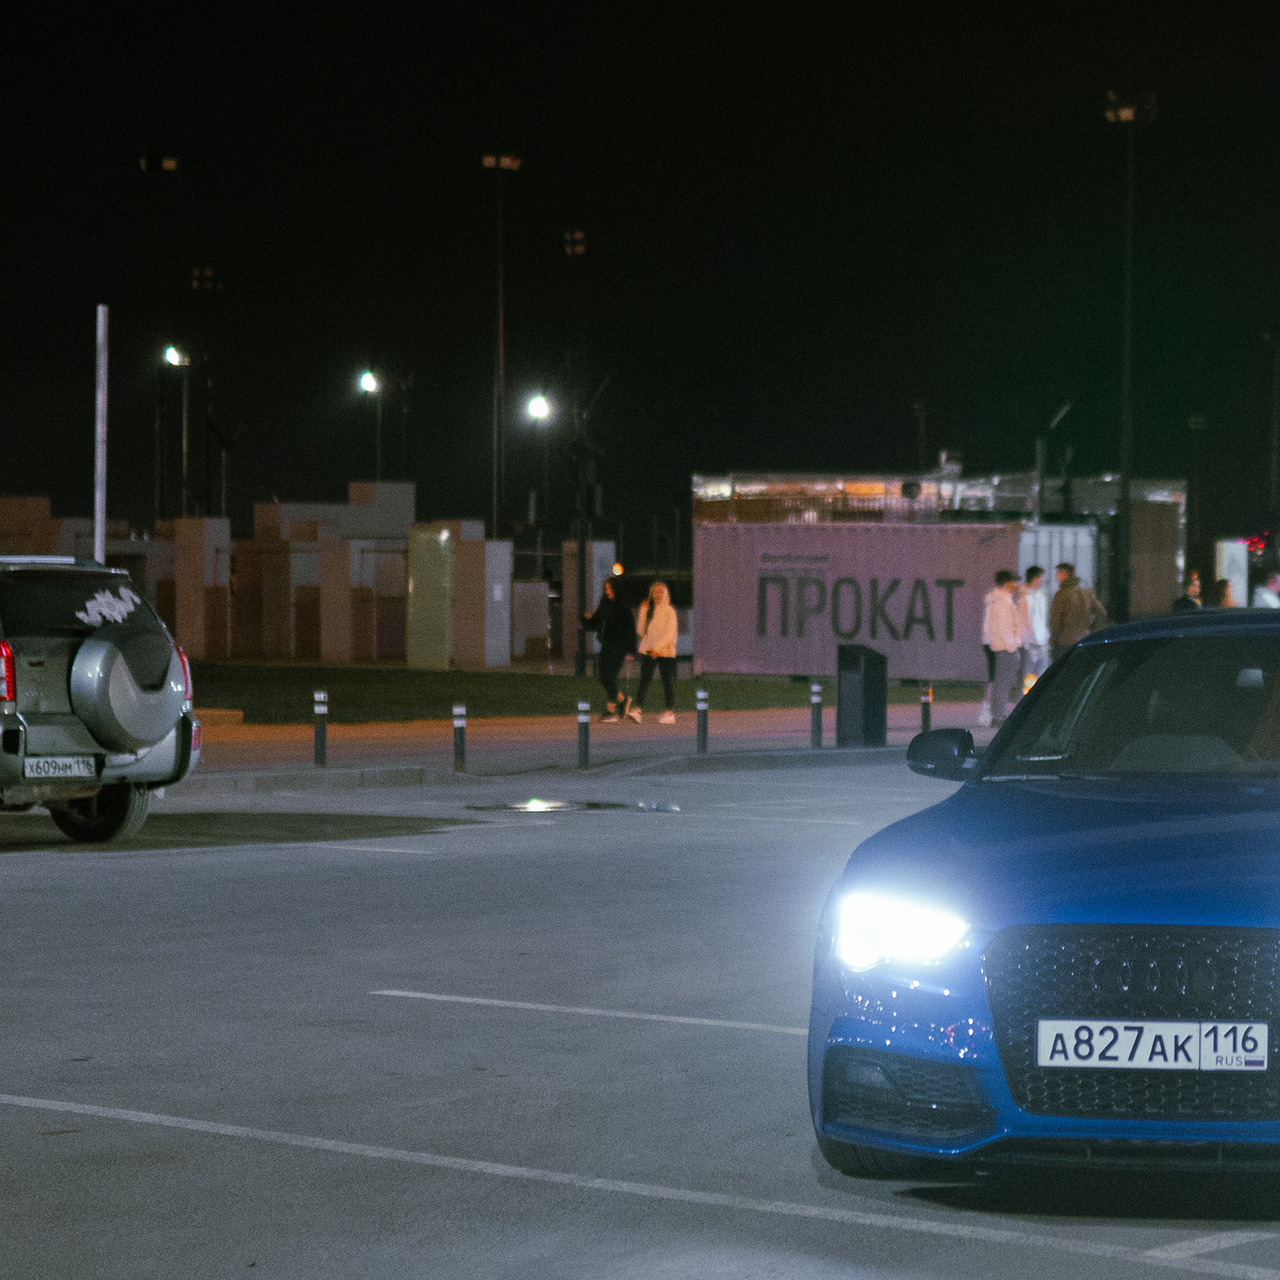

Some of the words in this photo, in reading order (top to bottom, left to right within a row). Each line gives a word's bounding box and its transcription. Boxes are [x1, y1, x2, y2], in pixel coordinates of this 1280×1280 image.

[756, 575, 965, 641] ПРОКАТ
[1204, 1025, 1259, 1054] 116
[1215, 1055, 1244, 1067] RUS
